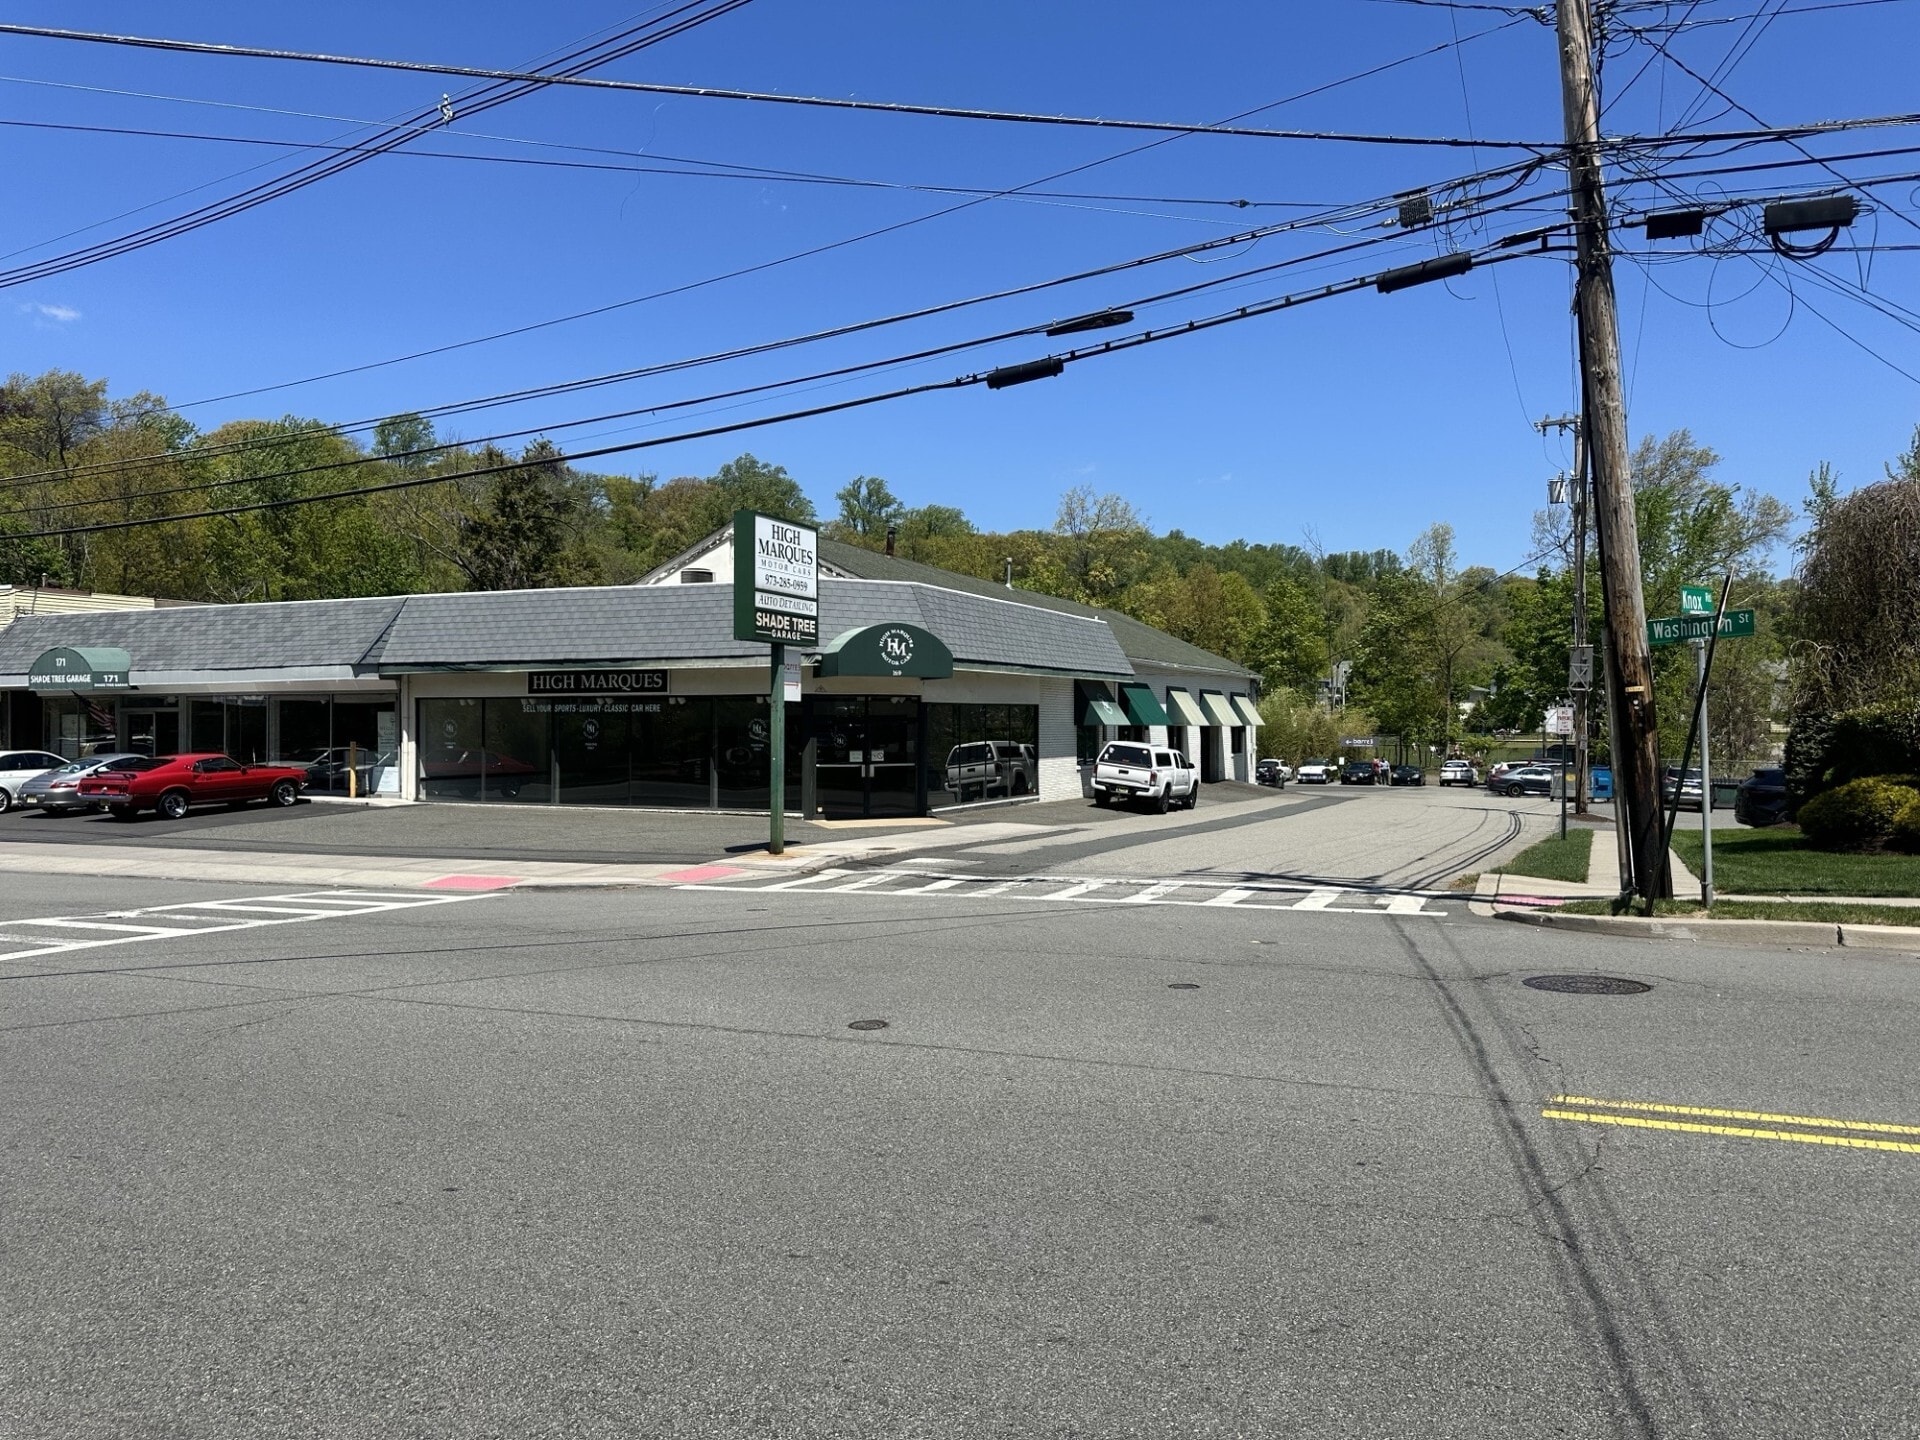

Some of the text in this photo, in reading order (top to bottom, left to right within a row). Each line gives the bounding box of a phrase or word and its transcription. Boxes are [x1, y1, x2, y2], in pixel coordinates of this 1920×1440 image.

[772, 524, 801, 546] HIGH
[758, 538, 813, 565] MARQUES
[761, 559, 811, 576] MOTOR CARS
[759, 595, 814, 612] AUTO DETAILING
[1682, 590, 1703, 610] Knox
[755, 612, 816, 633] SHADE TREE
[1738, 613, 1749, 623] St
[771, 629, 801, 640] GARAGE
[55, 657, 66, 667] 171
[30, 674, 91, 684] SHADE TREE GARAGE
[103, 674, 119, 682] 171
[532, 673, 663, 691] HIGH MARQUES
[522, 704, 536, 712] SELL
[537, 704, 551, 712] YOUR
[631, 704, 643, 712] CAR
[645, 704, 661, 712] HERE
